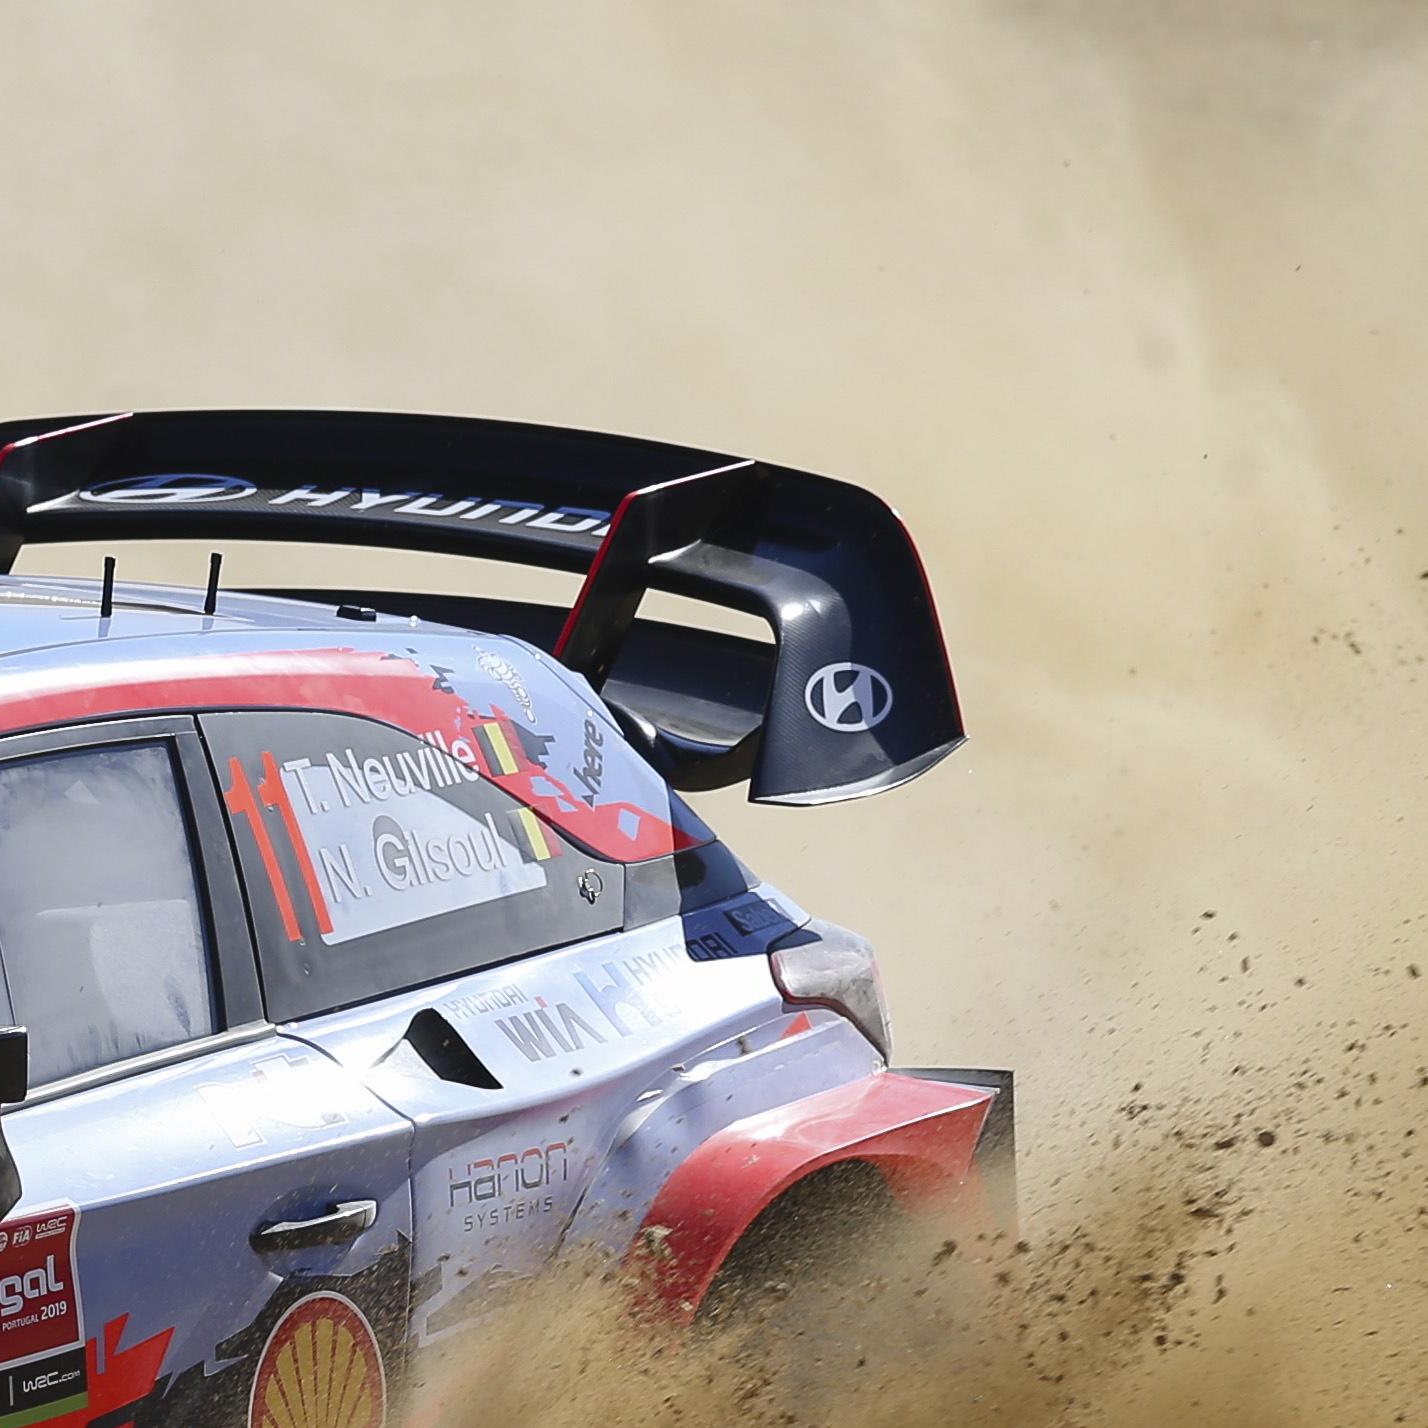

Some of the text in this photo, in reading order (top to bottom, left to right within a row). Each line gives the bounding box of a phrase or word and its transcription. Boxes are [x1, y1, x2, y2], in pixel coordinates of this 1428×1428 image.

[269, 484, 612, 536] HYUND
[325, 731, 481, 808] Neuville
[573, 719, 605, 796] here
[223, 751, 334, 941] 11
[318, 812, 509, 903] N. Gilsoul
[464, 1196, 553, 1233] SYSTEMS
[2, 1312, 40, 1332] PORTUGAL
[40, 1300, 68, 1321] 2019
